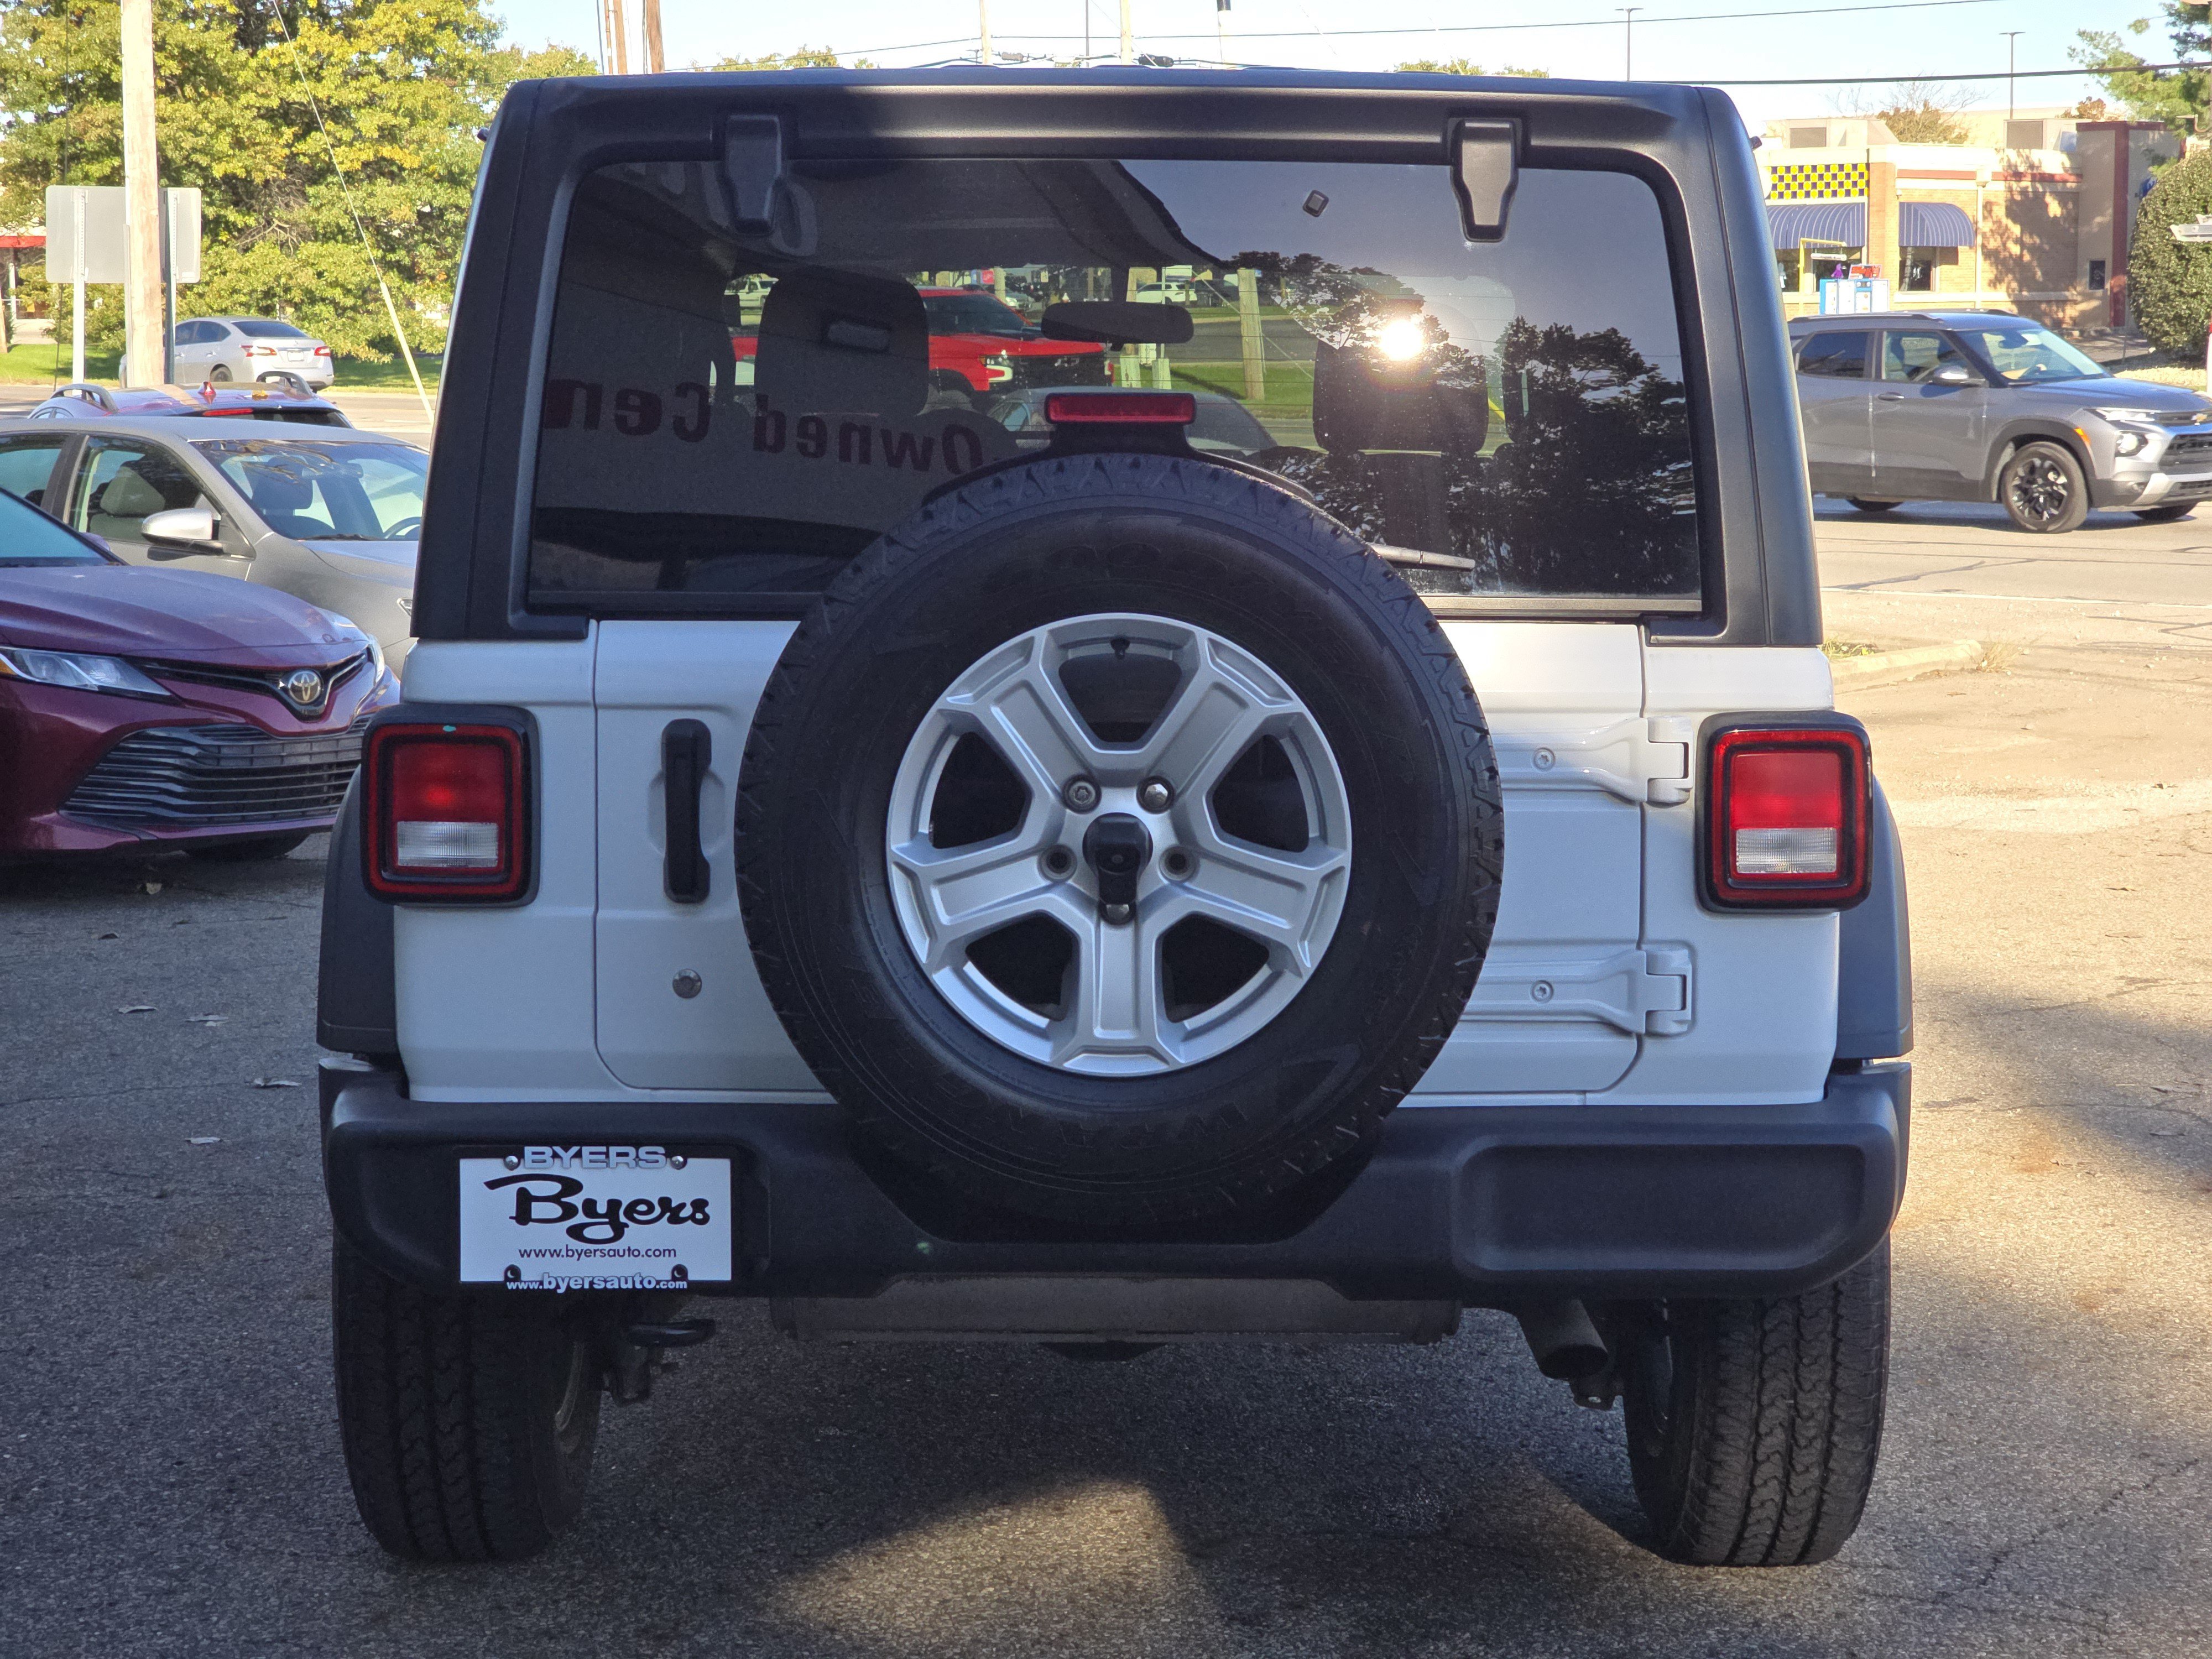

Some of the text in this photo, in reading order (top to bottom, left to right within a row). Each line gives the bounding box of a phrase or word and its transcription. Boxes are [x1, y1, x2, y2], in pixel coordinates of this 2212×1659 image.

[524, 1146, 666, 1169] BYERS
[483, 1173, 710, 1245] Byers
[518, 1244, 676, 1261] www.byersauto.com
[507, 1272, 687, 1293] www.byersauto.com
